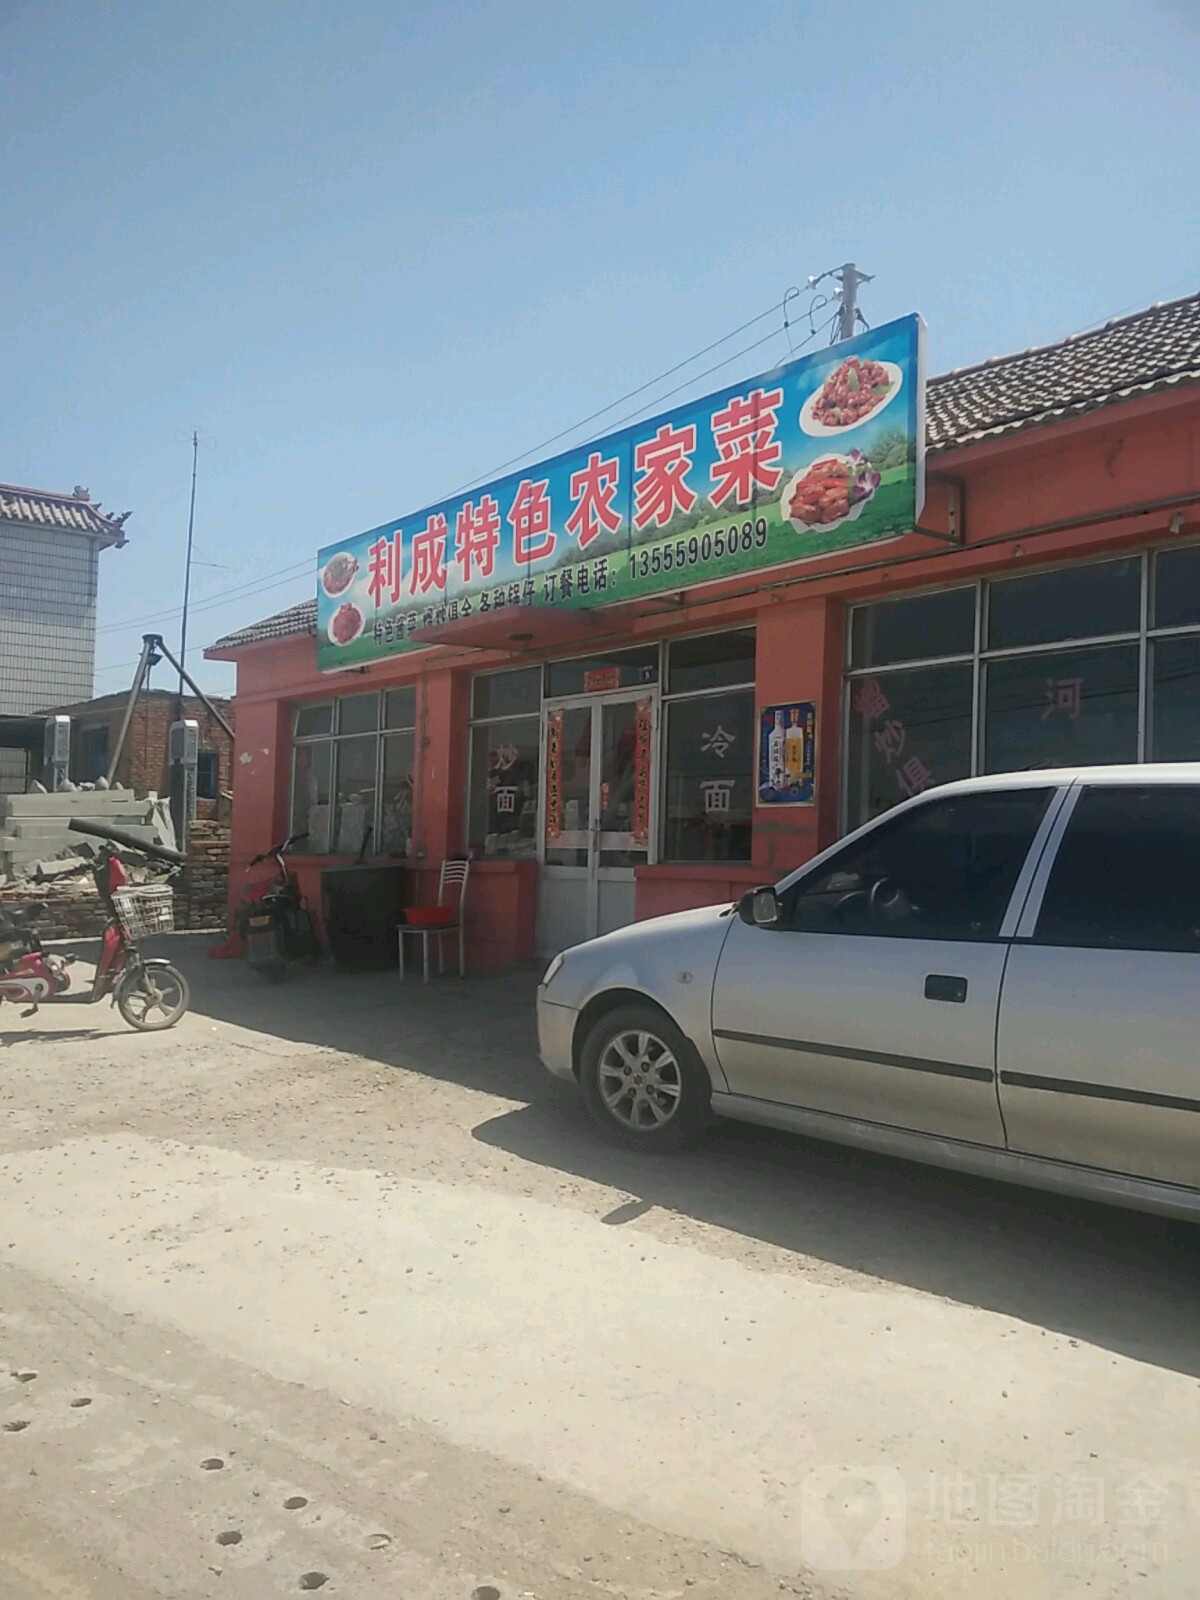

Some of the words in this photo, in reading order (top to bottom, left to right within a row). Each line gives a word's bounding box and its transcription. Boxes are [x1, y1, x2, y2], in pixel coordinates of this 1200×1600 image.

[366, 388, 784, 609] 利成特色农家菜
[629, 518, 769, 579] 13555905089
[700, 726, 737, 813] 冷面
